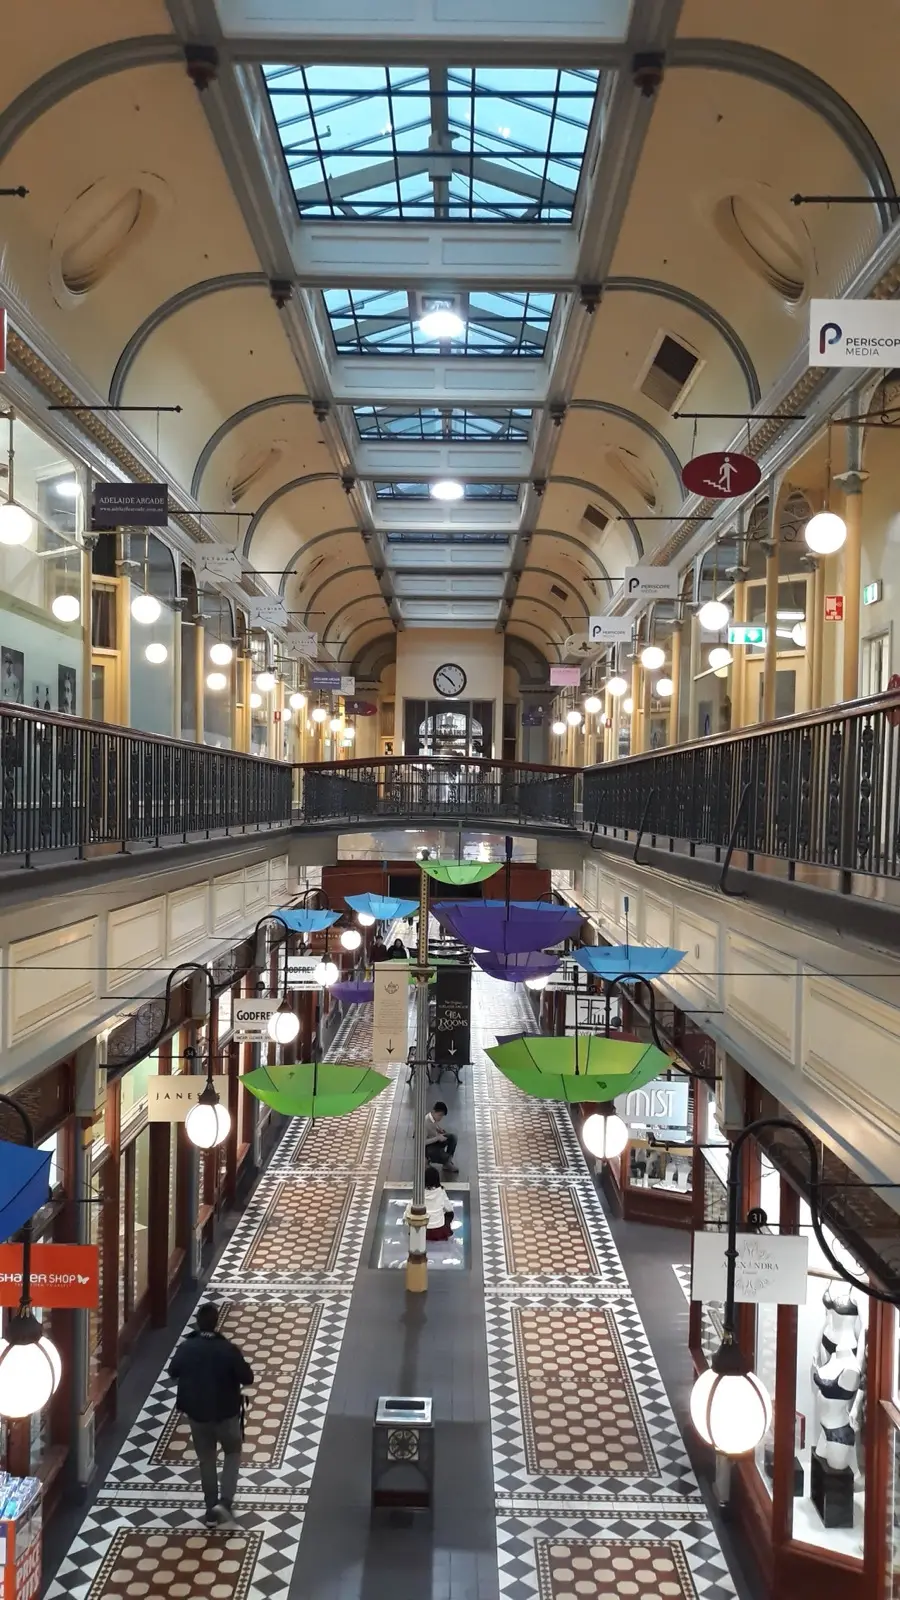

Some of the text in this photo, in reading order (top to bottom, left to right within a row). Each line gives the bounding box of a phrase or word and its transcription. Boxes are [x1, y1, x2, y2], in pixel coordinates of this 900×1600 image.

[845, 348, 880, 356] MEDIA
[99, 496, 164, 505] ADELAIDE ARCADE
[236, 1010, 276, 1021] GODFRE
[751, 1213, 762, 1223] 31
[48, 1273, 76, 1283] SHOP
